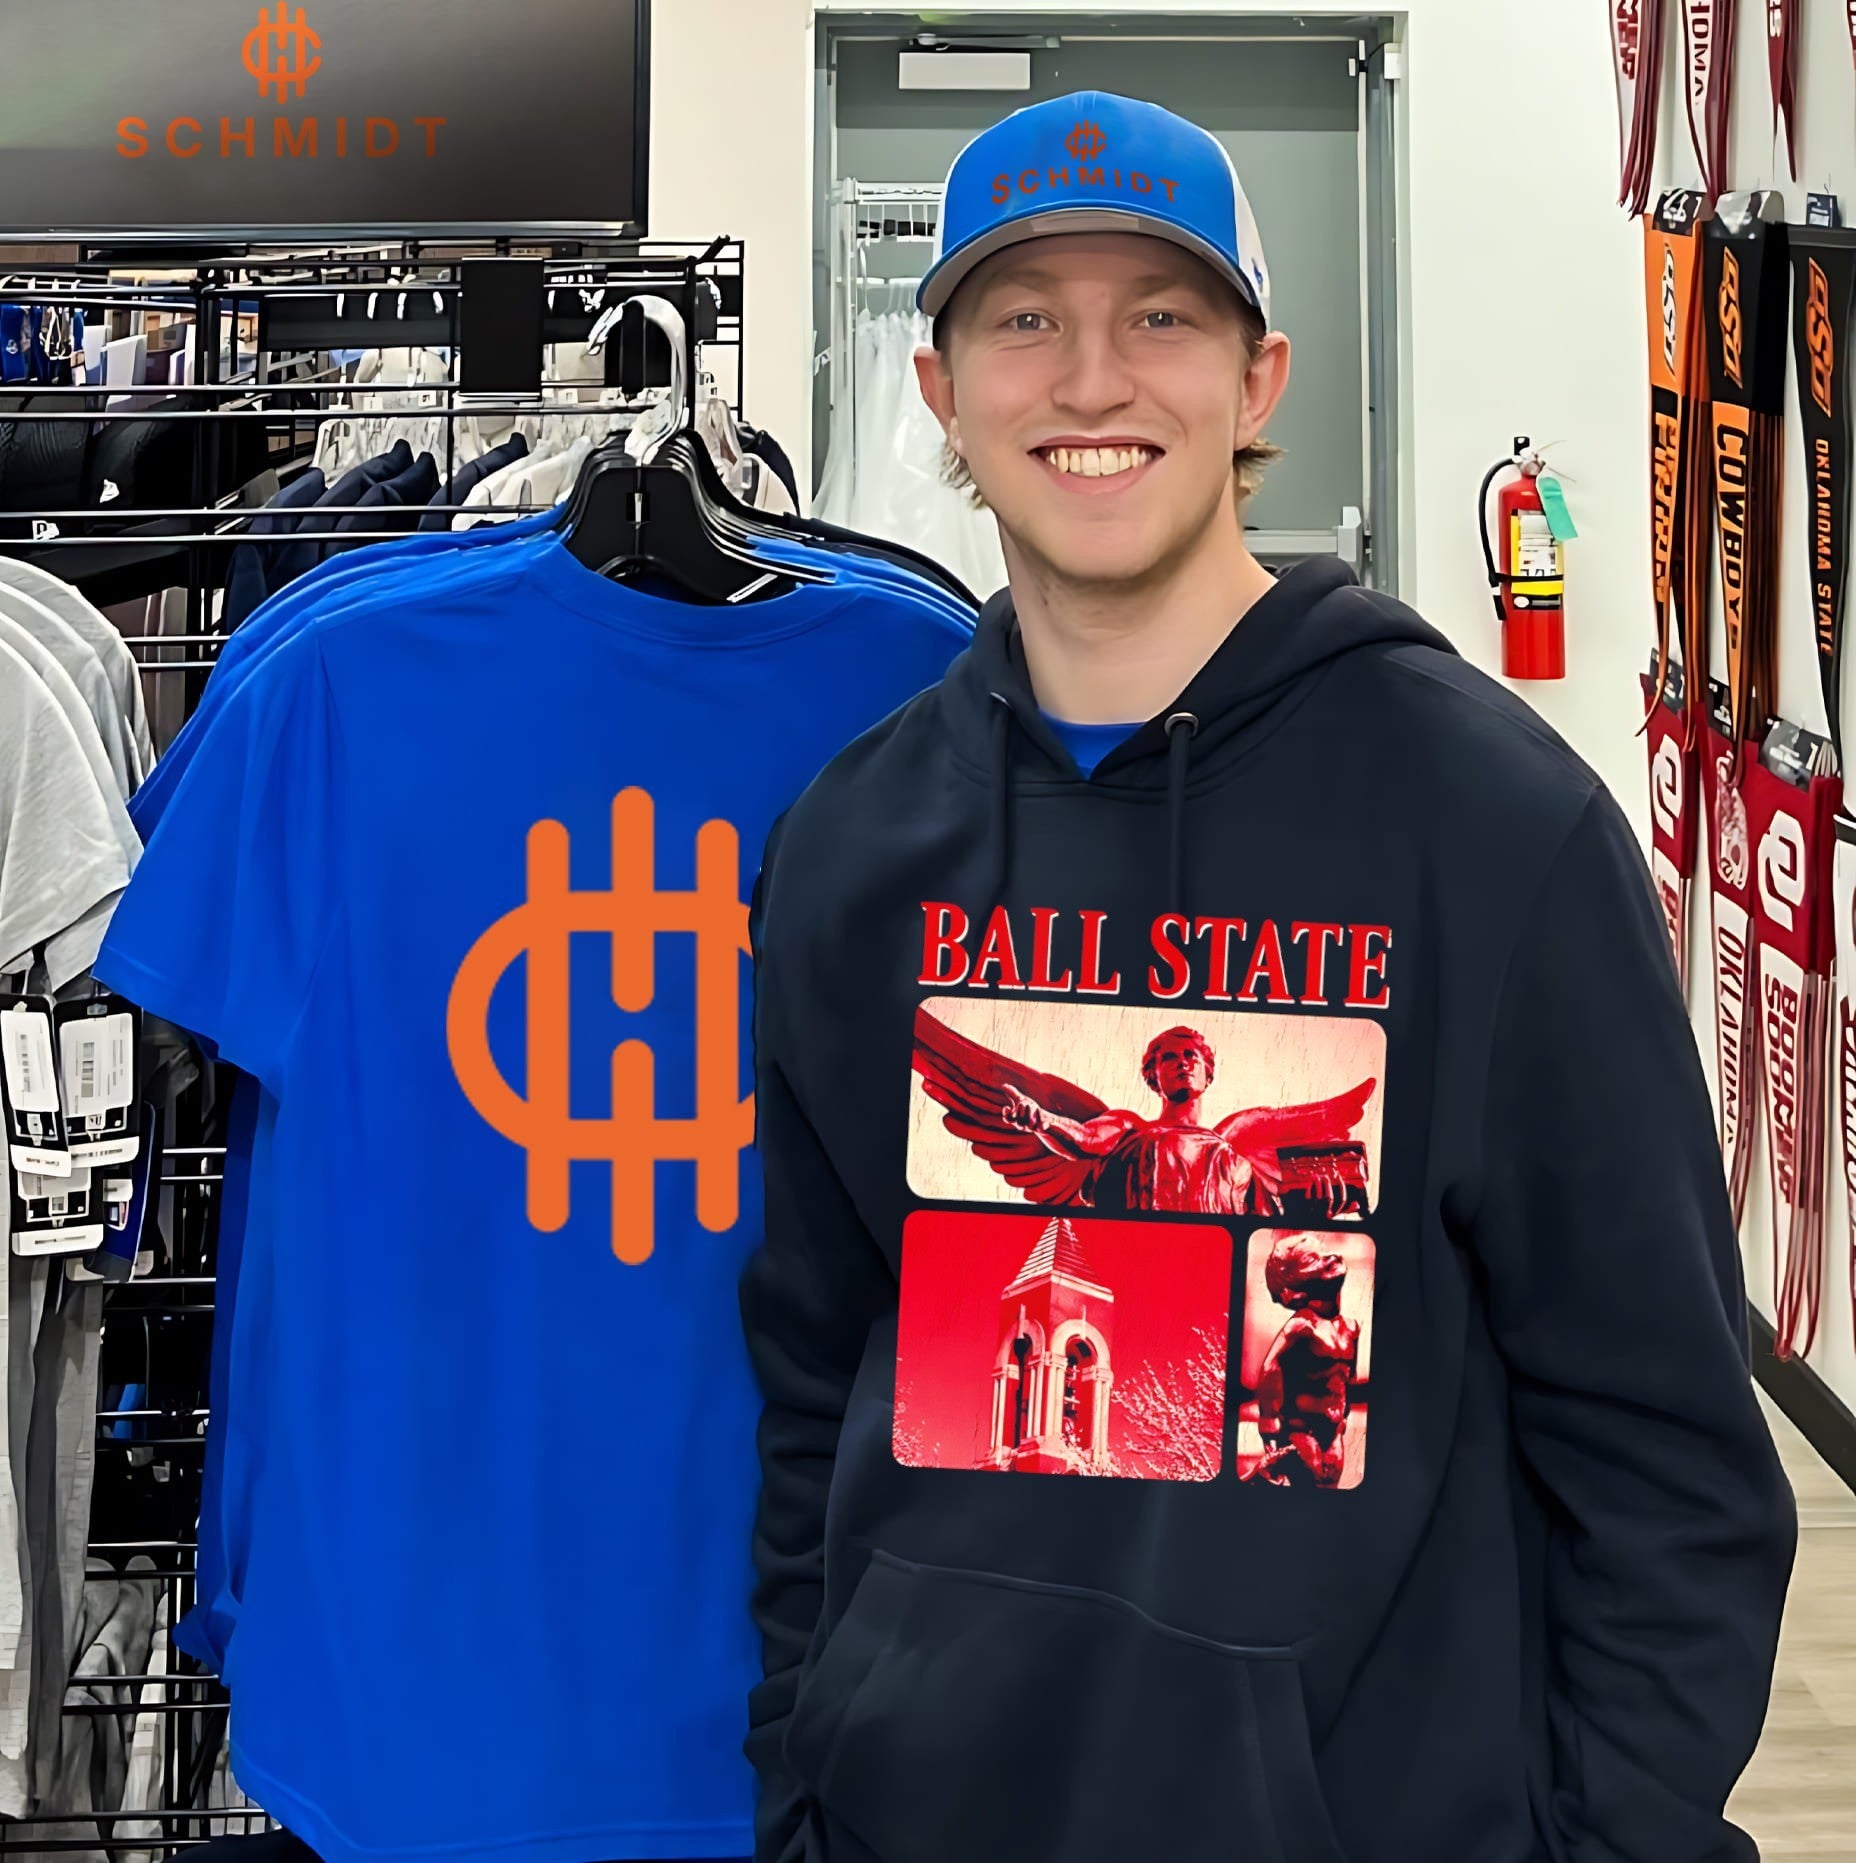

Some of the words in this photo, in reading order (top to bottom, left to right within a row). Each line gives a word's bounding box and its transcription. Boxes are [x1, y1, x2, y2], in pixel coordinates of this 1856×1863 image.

[115, 116, 447, 158] SCHMIDT
[992, 166, 1179, 204] SCHMIDT
[1815, 438, 1832, 570] OKLAHOMA
[917, 901, 1121, 995] BALL
[1147, 912, 1393, 1009] STATE
[1718, 925, 1745, 1144] OKLAHOMA
